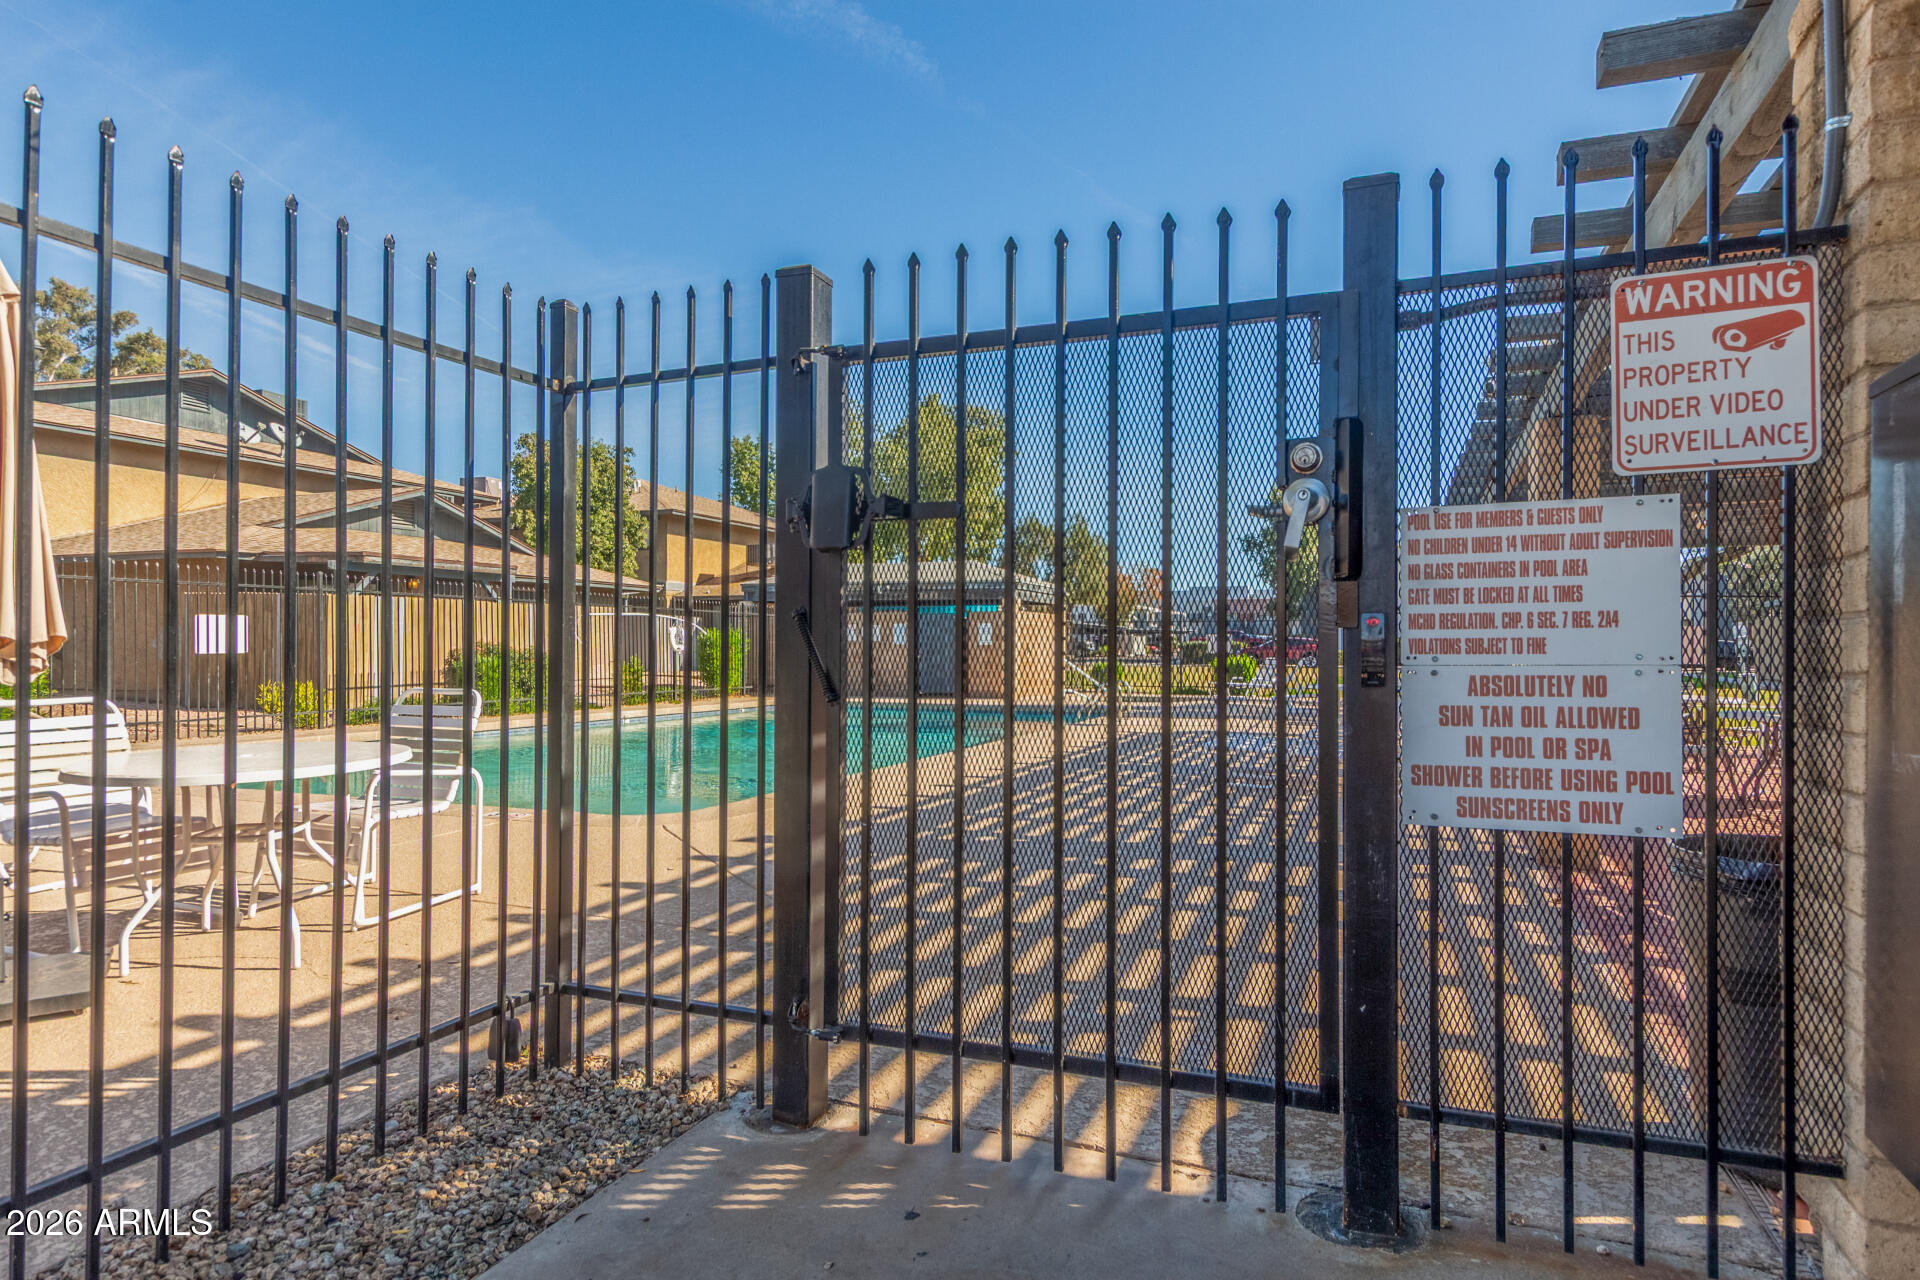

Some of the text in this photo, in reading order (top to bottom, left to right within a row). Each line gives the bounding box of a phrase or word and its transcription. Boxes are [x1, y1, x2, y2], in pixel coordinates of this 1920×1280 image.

[1625, 268, 1801, 315] WARNING
[1623, 330, 1675, 355] THIS
[1623, 357, 1752, 389] PROPERTY
[1623, 389, 1783, 422] UNDER VIDEO
[1624, 422, 1808, 456] SURVEILLANCE
[1408, 506, 1603, 531] POOL USE FOR MEMBERS & GUESTS ONLY
[1408, 529, 1673, 556] NO CHILDREN UNDER 14 WITHOUT ADULT SUPERVISION
[1408, 559, 1588, 580] NO GLASS CONTAINERS IN POOL AREA
[1408, 585, 1583, 605] GATE MUST BE LOCKED AT ALL TIMES
[1439, 612, 1498, 629] REGULATION.
[1502, 612, 1523, 629] CHP.
[1527, 612, 1533, 628] 6
[1538, 611, 1559, 628] SEC.
[1562, 611, 1568, 628] 7
[1572, 611, 1594, 628] REG.
[1598, 610, 1619, 628] 2A4
[1408, 637, 1547, 655] VIOLATIONS SUBJECT TO FINE
[1467, 675, 1607, 698] ABSOLUTELY NO
[1439, 705, 1640, 730] SUN TAN OIL ALLOWED
[1465, 736, 1611, 761] IN POOL OR SPA
[1411, 764, 1674, 795] SHOWER BEFORE USING POOL
[1457, 796, 1623, 824] SUNSCREENS ONLY
